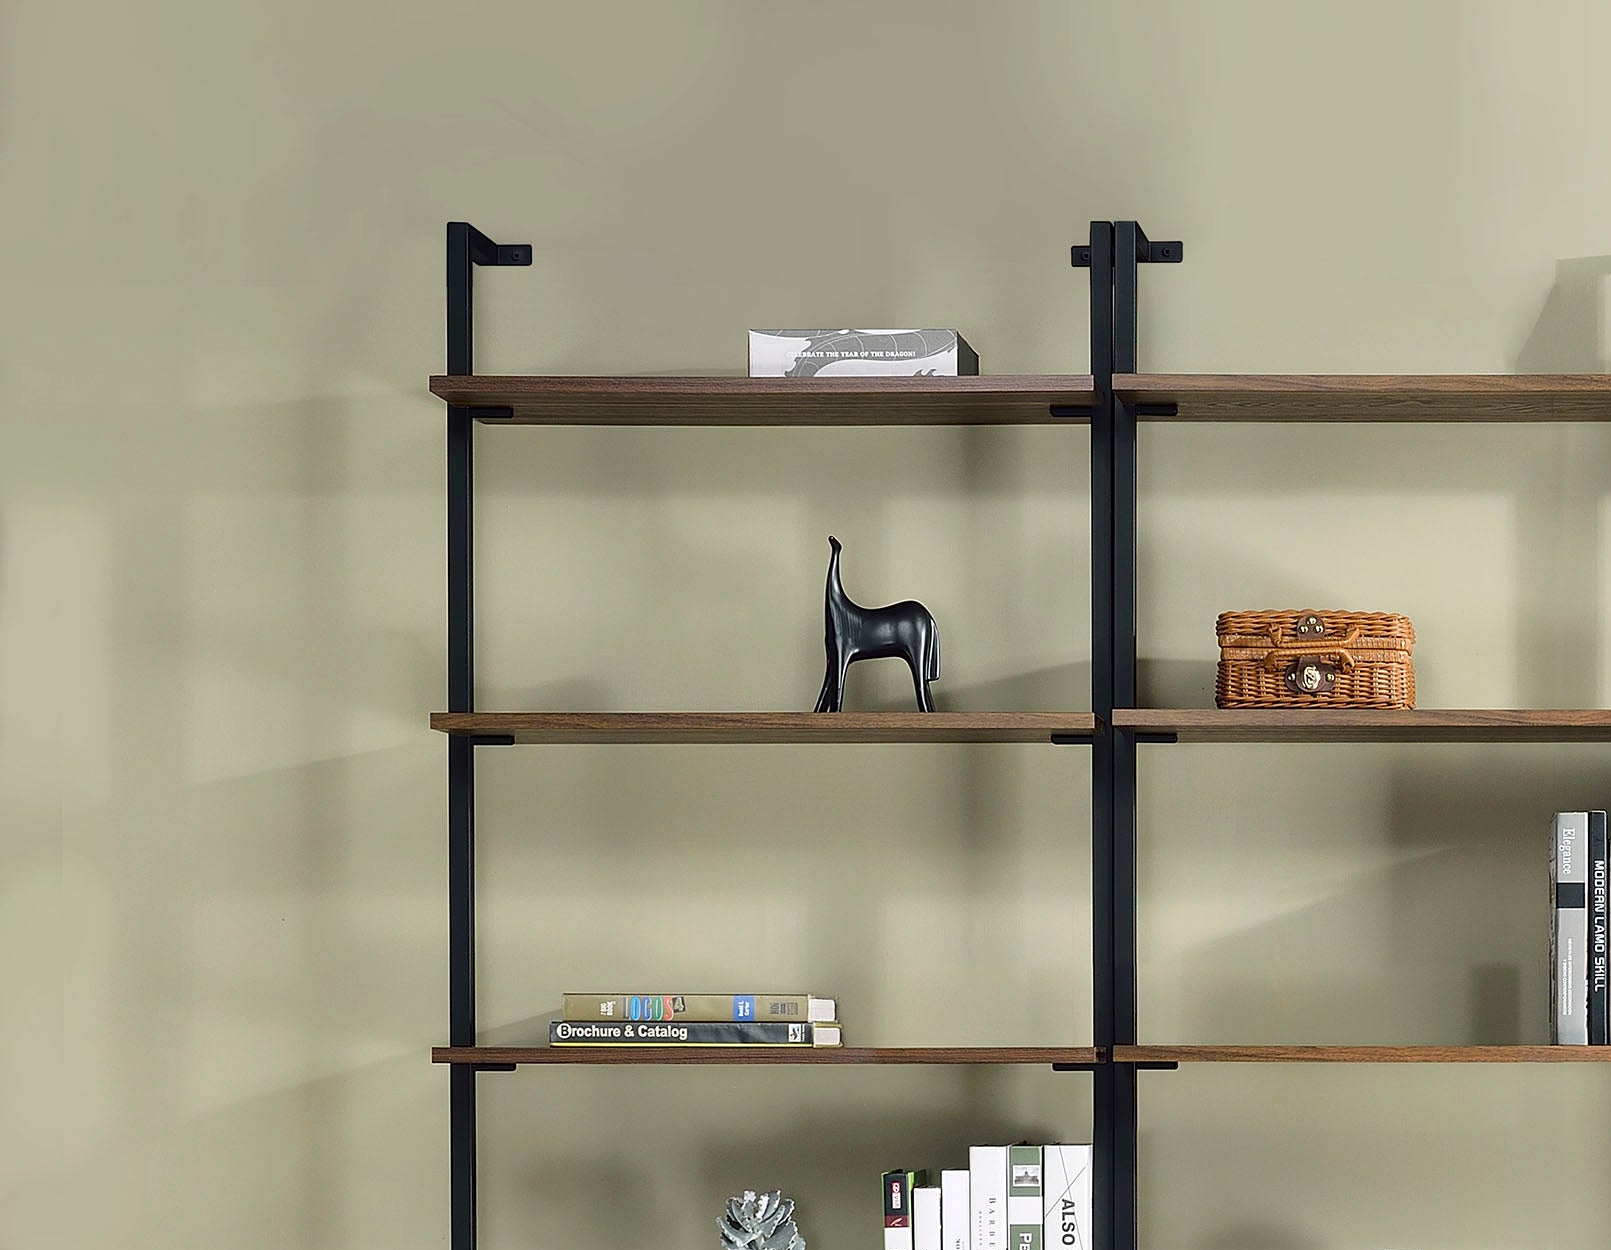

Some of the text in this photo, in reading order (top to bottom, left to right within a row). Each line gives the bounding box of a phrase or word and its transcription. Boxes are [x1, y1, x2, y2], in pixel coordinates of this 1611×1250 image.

[1559, 827, 1576, 875] Elegance
[1594, 860, 1605, 913] MODERN
[1594, 956, 1605, 992] SKILL
[556, 1023, 688, 1041] Brochure & Catalog
[1061, 1198, 1076, 1246] ALSO
